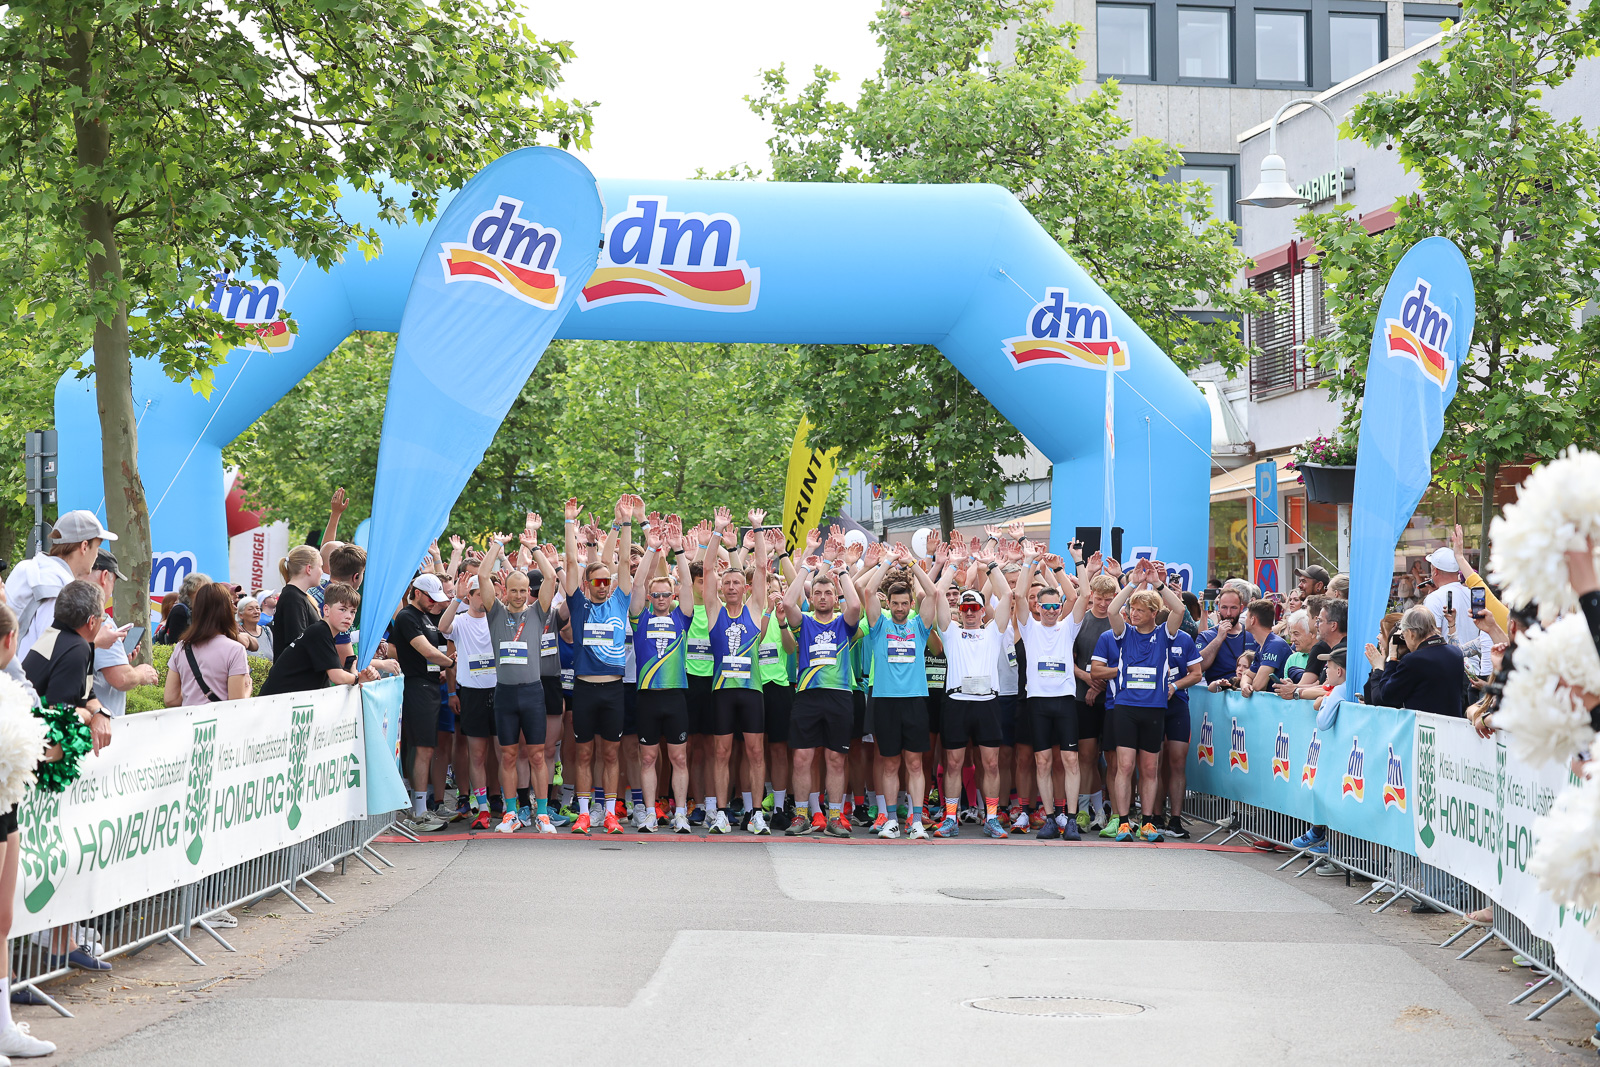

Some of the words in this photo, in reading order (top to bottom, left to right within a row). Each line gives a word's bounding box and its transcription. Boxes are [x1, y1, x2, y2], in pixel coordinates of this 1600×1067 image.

[472, 202, 556, 270] dm
[609, 201, 732, 266] dm
[1032, 292, 1108, 340] dm
[1402, 284, 1449, 351] dm
[785, 446, 826, 558] SPRINT
[1261, 471, 1272, 517] P
[1200, 715, 1213, 746] dm
[1231, 720, 1245, 752] dm
[1275, 726, 1289, 760] dm
[1306, 731, 1321, 767] dm
[306, 752, 361, 804] HOMBURG
[1347, 739, 1364, 778] dm
[1387, 746, 1403, 787] dm
[70, 770, 99, 807] Kreis-
[213, 772, 285, 833] HOMBURG
[73, 799, 180, 875] HOMBURG
[1439, 793, 1496, 854] HOMBURG
